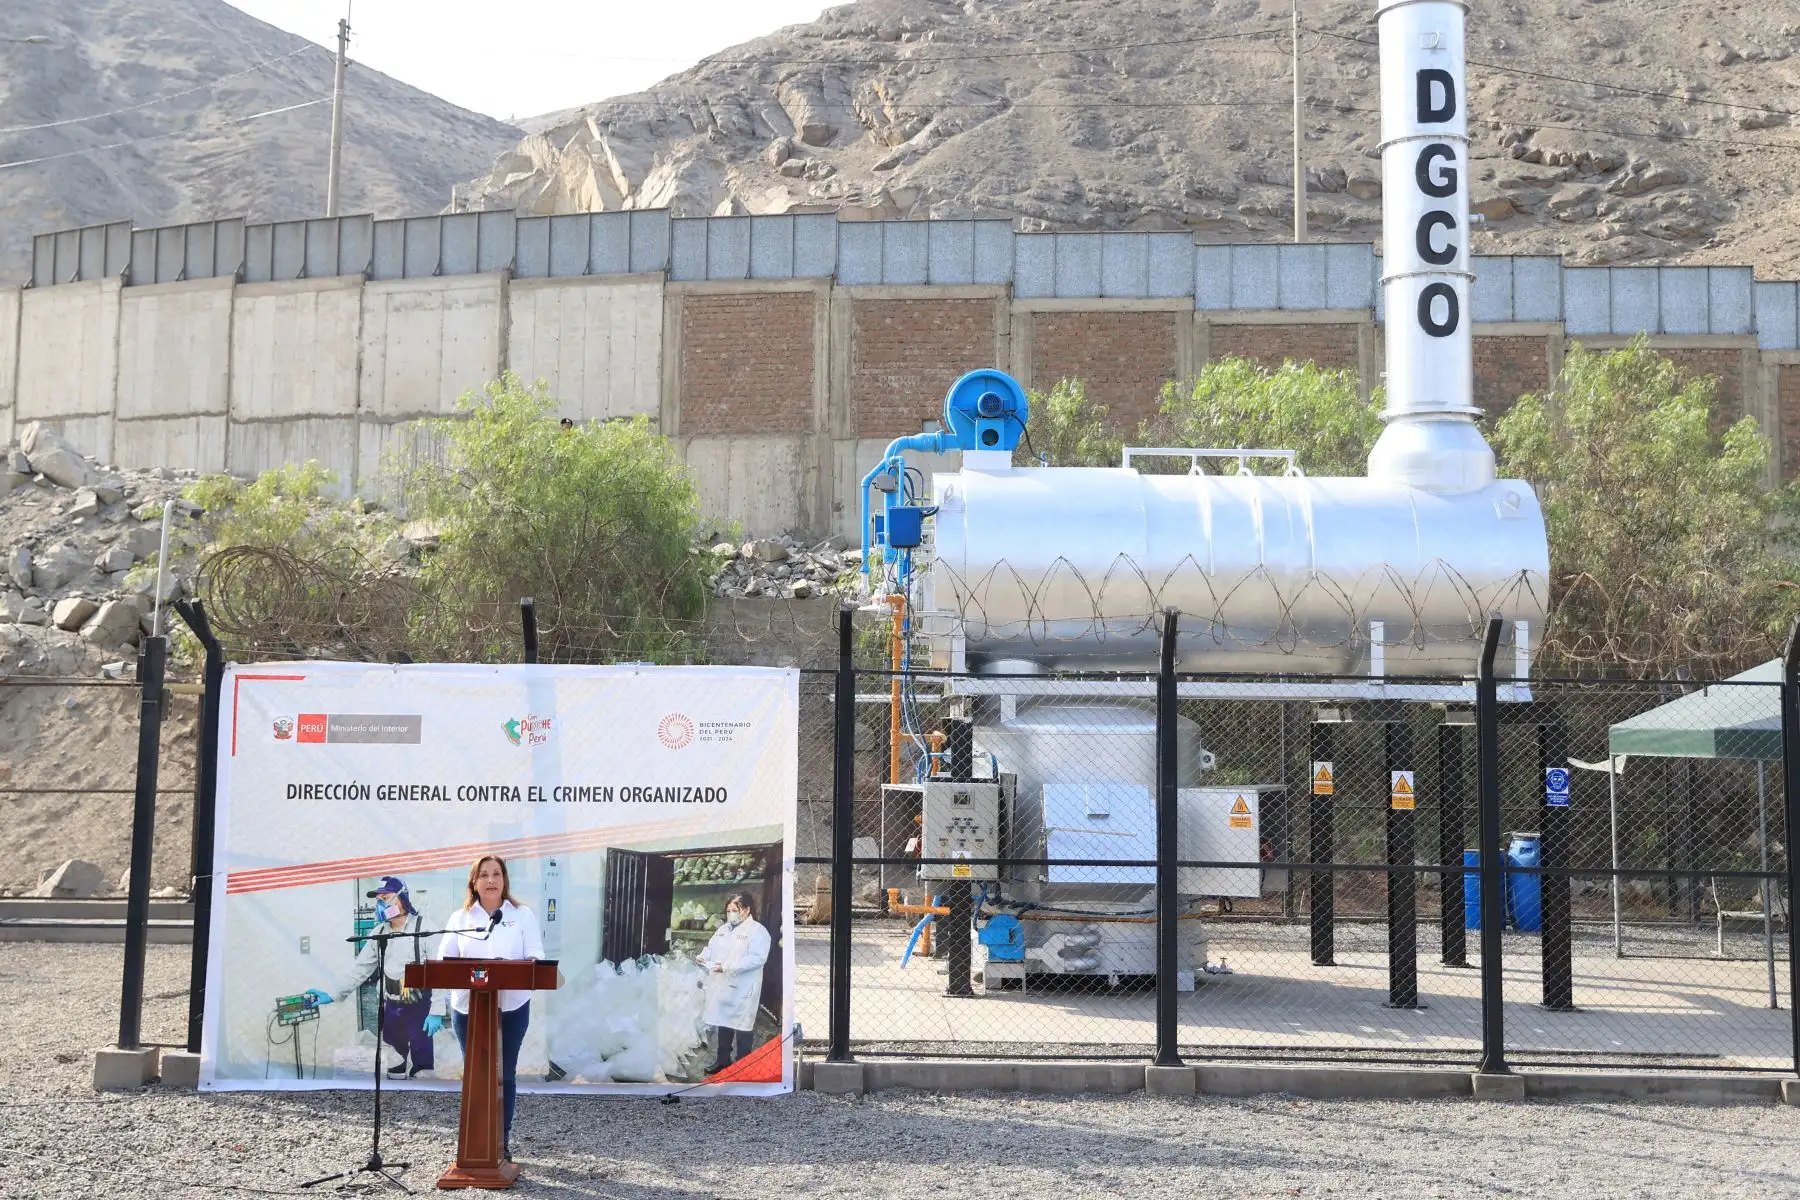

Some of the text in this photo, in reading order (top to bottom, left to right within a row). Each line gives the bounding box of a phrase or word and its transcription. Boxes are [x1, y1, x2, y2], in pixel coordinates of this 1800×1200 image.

[300, 722, 324, 733] PERÚ
[330, 724, 409, 733] Ministerio del Interior
[286, 780, 728, 803] DIRECCIÓN GENERAL CONTRA EL CRIMEN ORGANIZADO
